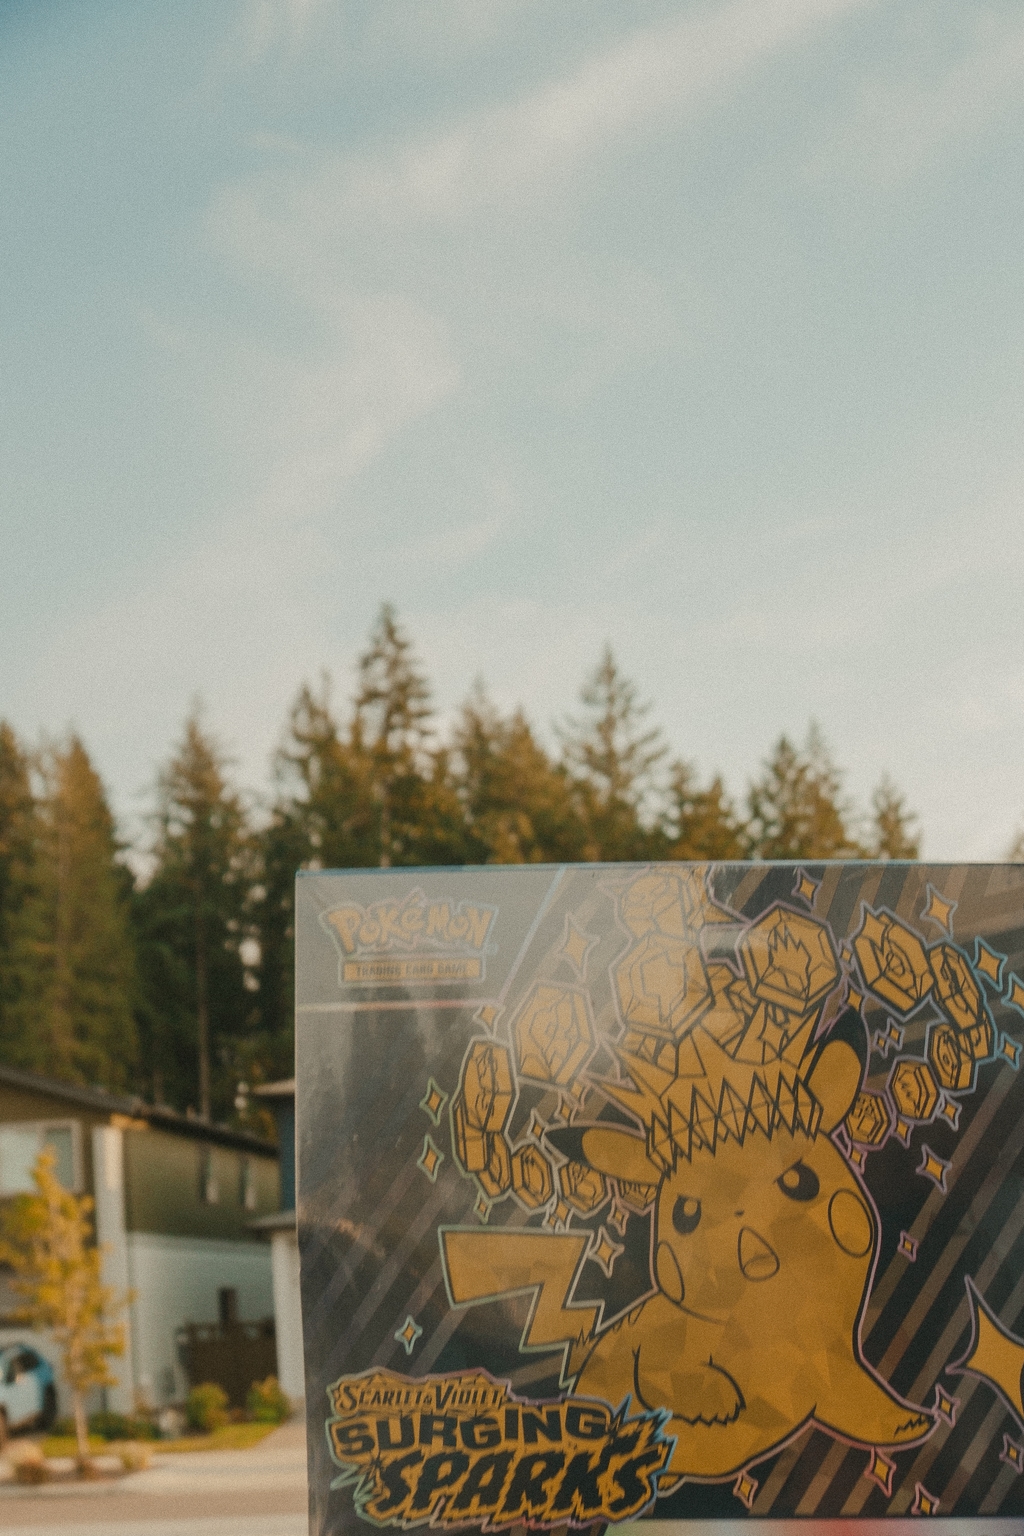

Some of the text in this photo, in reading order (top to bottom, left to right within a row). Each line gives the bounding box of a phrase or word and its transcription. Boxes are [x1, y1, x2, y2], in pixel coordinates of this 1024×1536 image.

[356, 963, 466, 977] TRADING CARD GAME
[335, 1404, 613, 1457] SURGING
[371, 1426, 662, 1520] SPARKS
